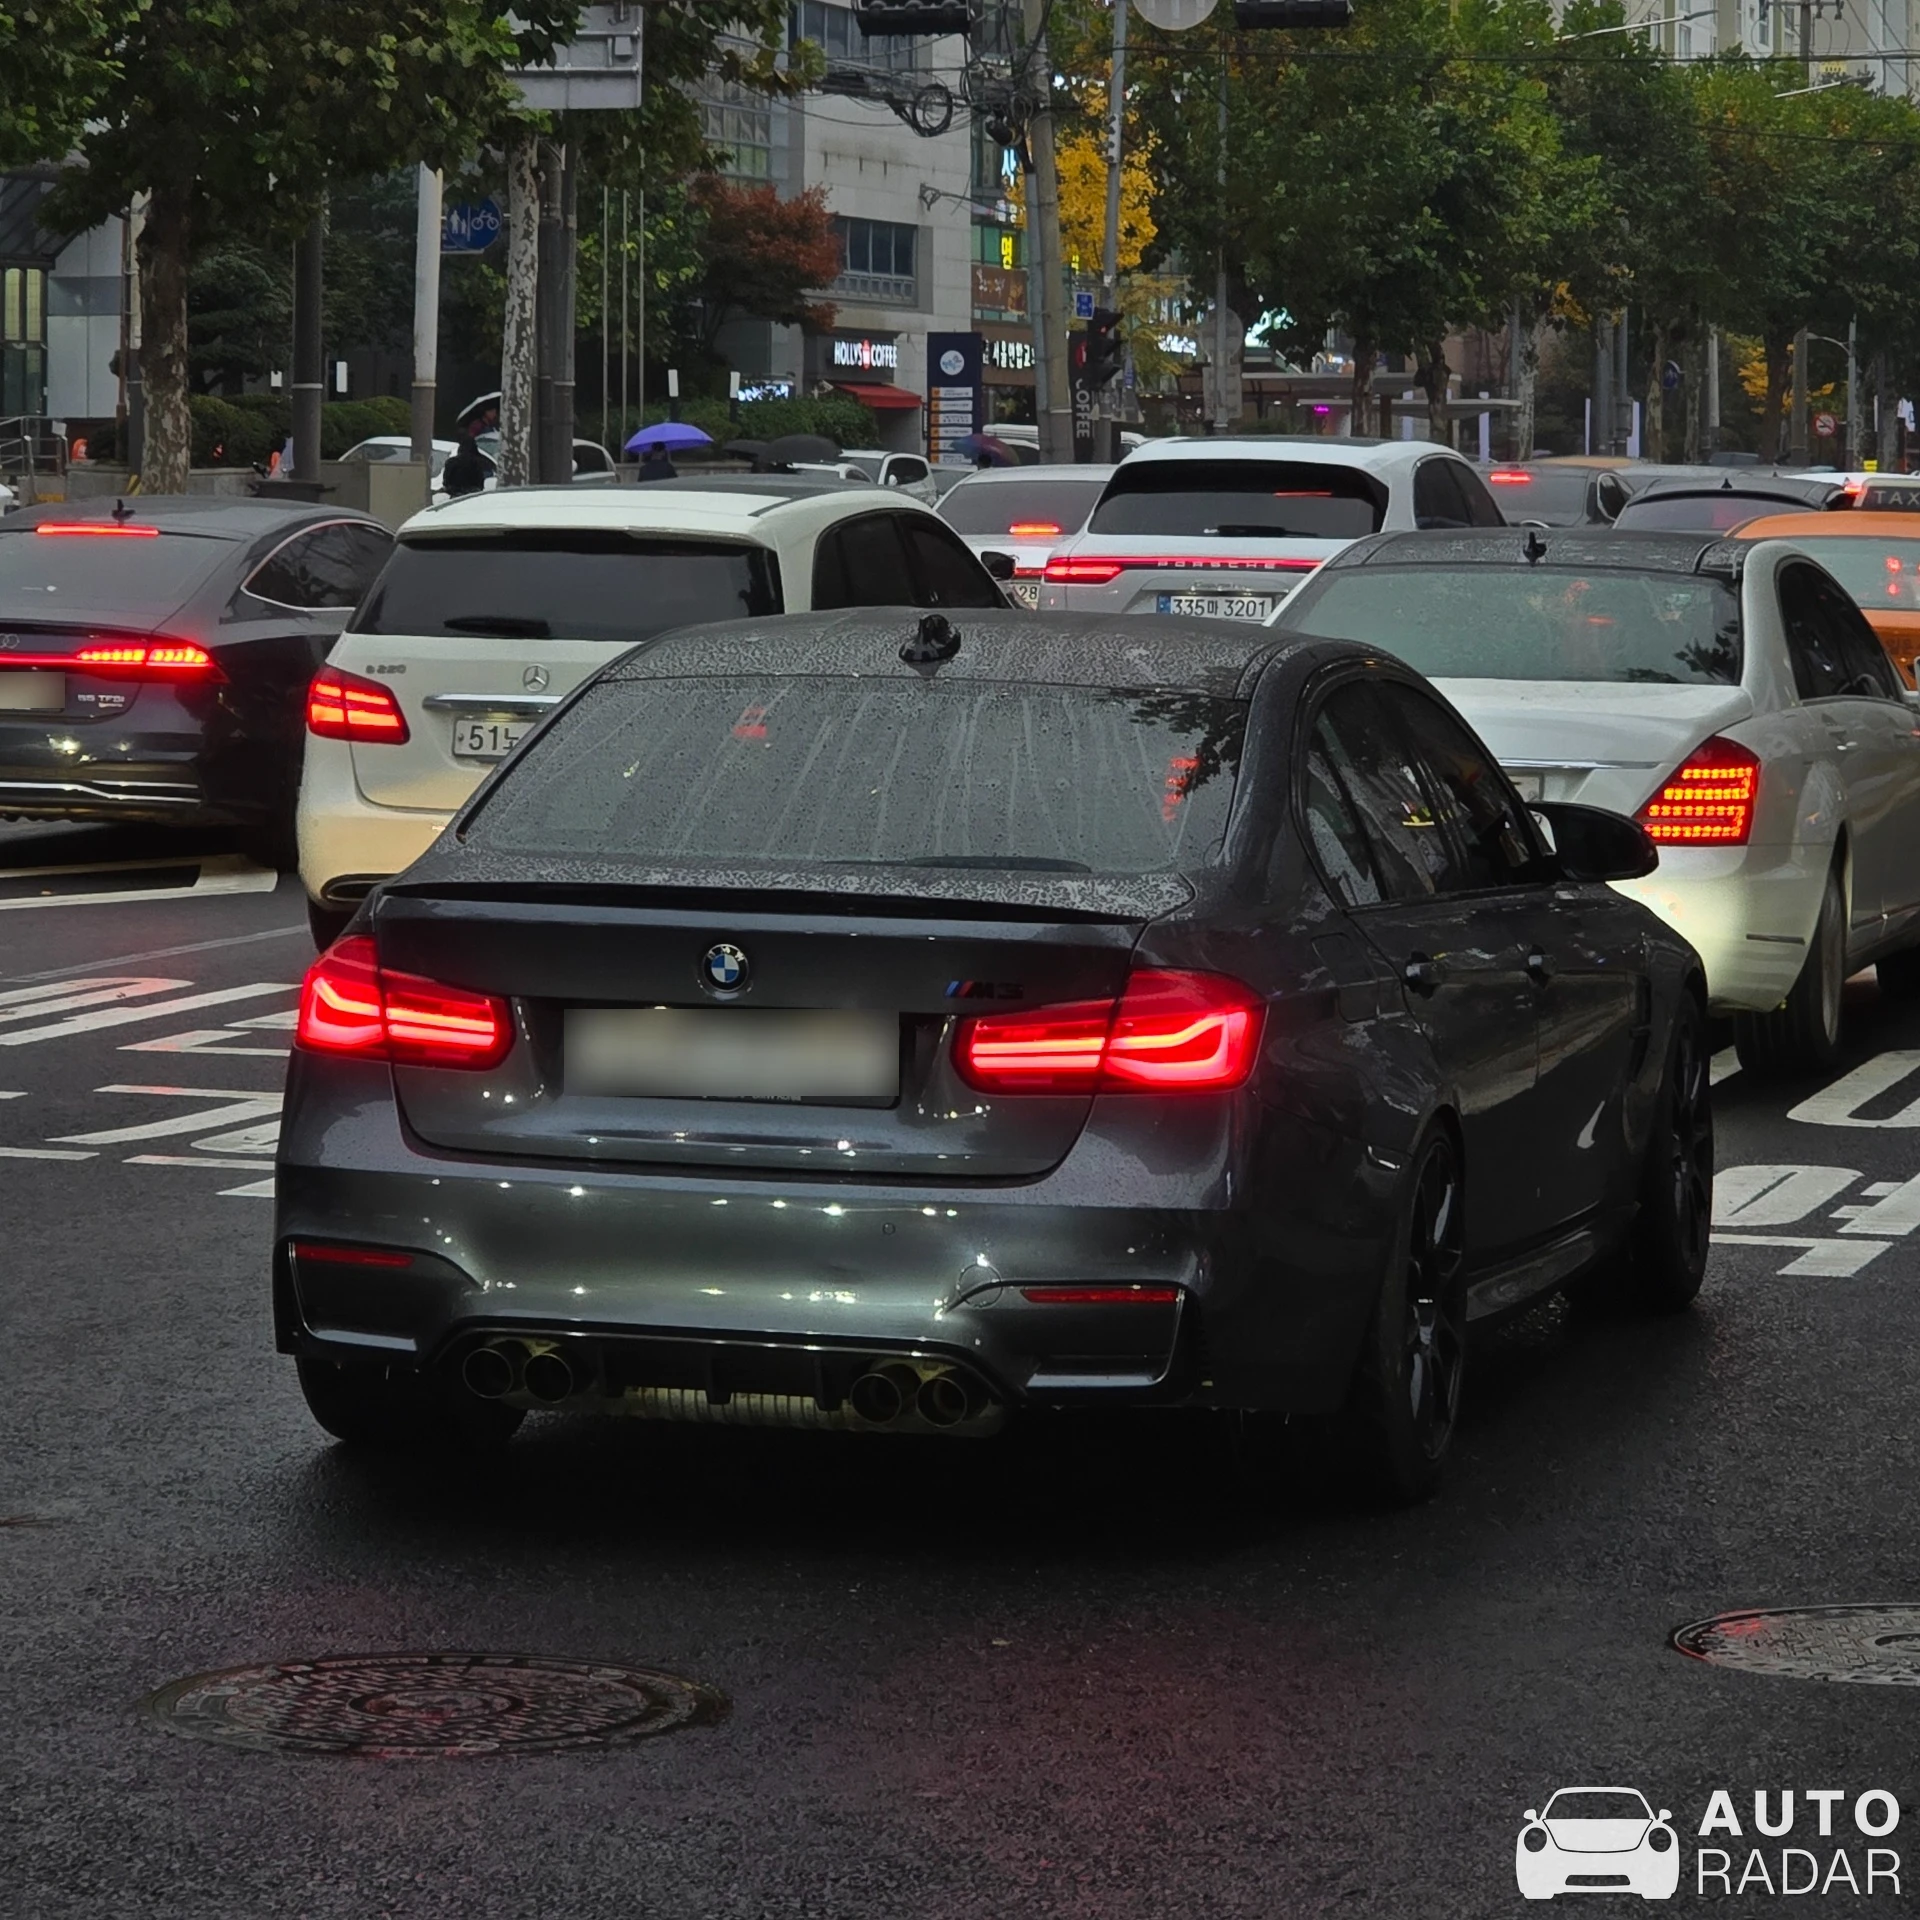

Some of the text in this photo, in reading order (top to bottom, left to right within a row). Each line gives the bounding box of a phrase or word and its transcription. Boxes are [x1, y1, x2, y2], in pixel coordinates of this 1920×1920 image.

[834, 341, 898, 368] HOLLYS COFFEE
[1172, 598, 1266, 618] 335마 3201
[968, 980, 1024, 1000] M3
